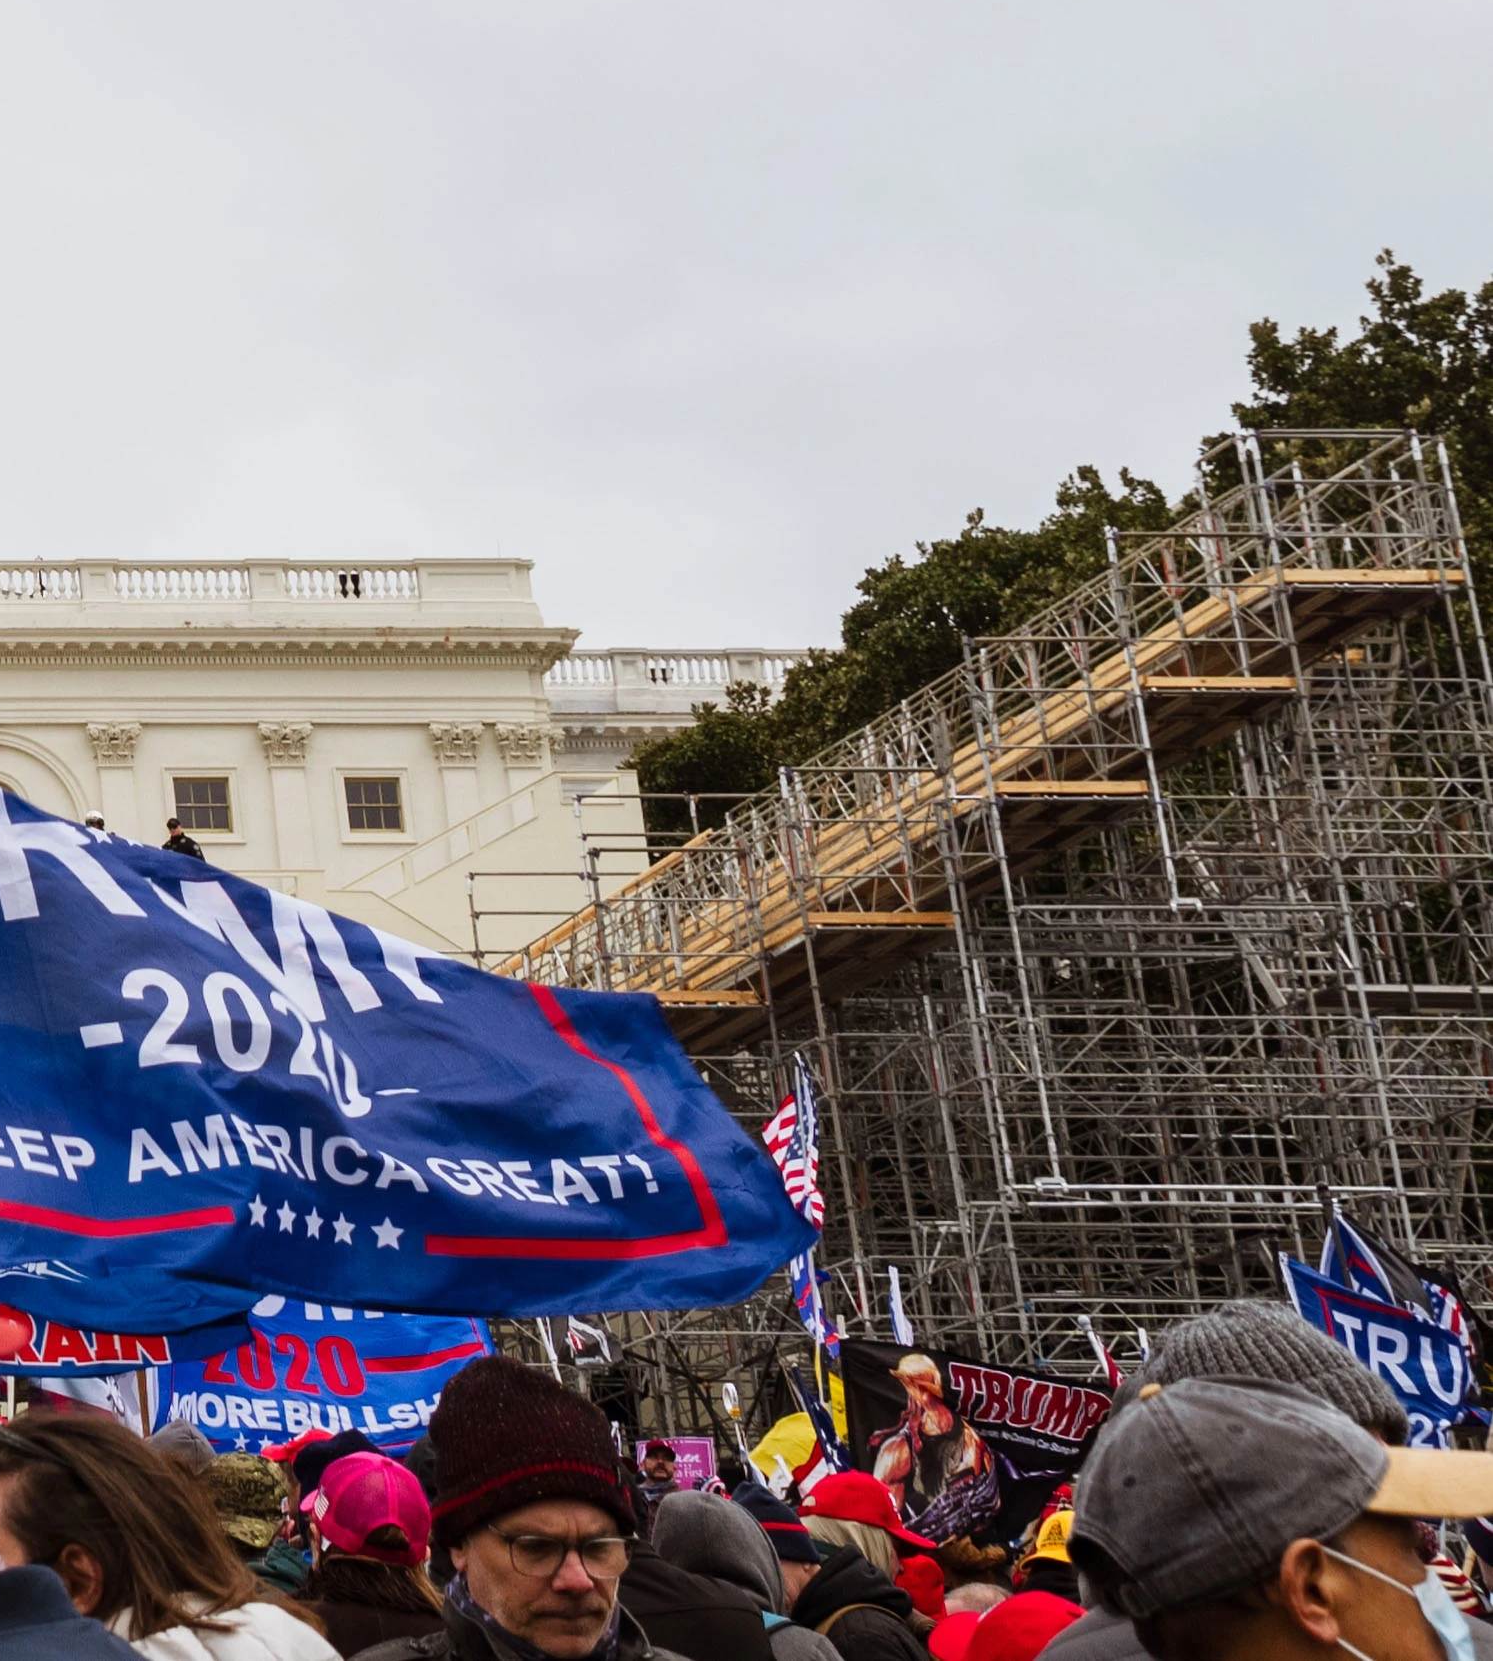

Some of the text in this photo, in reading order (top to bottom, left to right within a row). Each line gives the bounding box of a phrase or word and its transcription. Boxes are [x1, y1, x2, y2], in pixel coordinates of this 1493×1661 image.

[127, 1113, 430, 1194] AMERICA
[427, 1154, 659, 1208] GREAT!
[202, 1325, 367, 1399] 2020
[1332, 1310, 1463, 1407] TRU
[282, 1392, 442, 1437] BULLSH
[948, 1361, 1113, 1442] TRUMP
